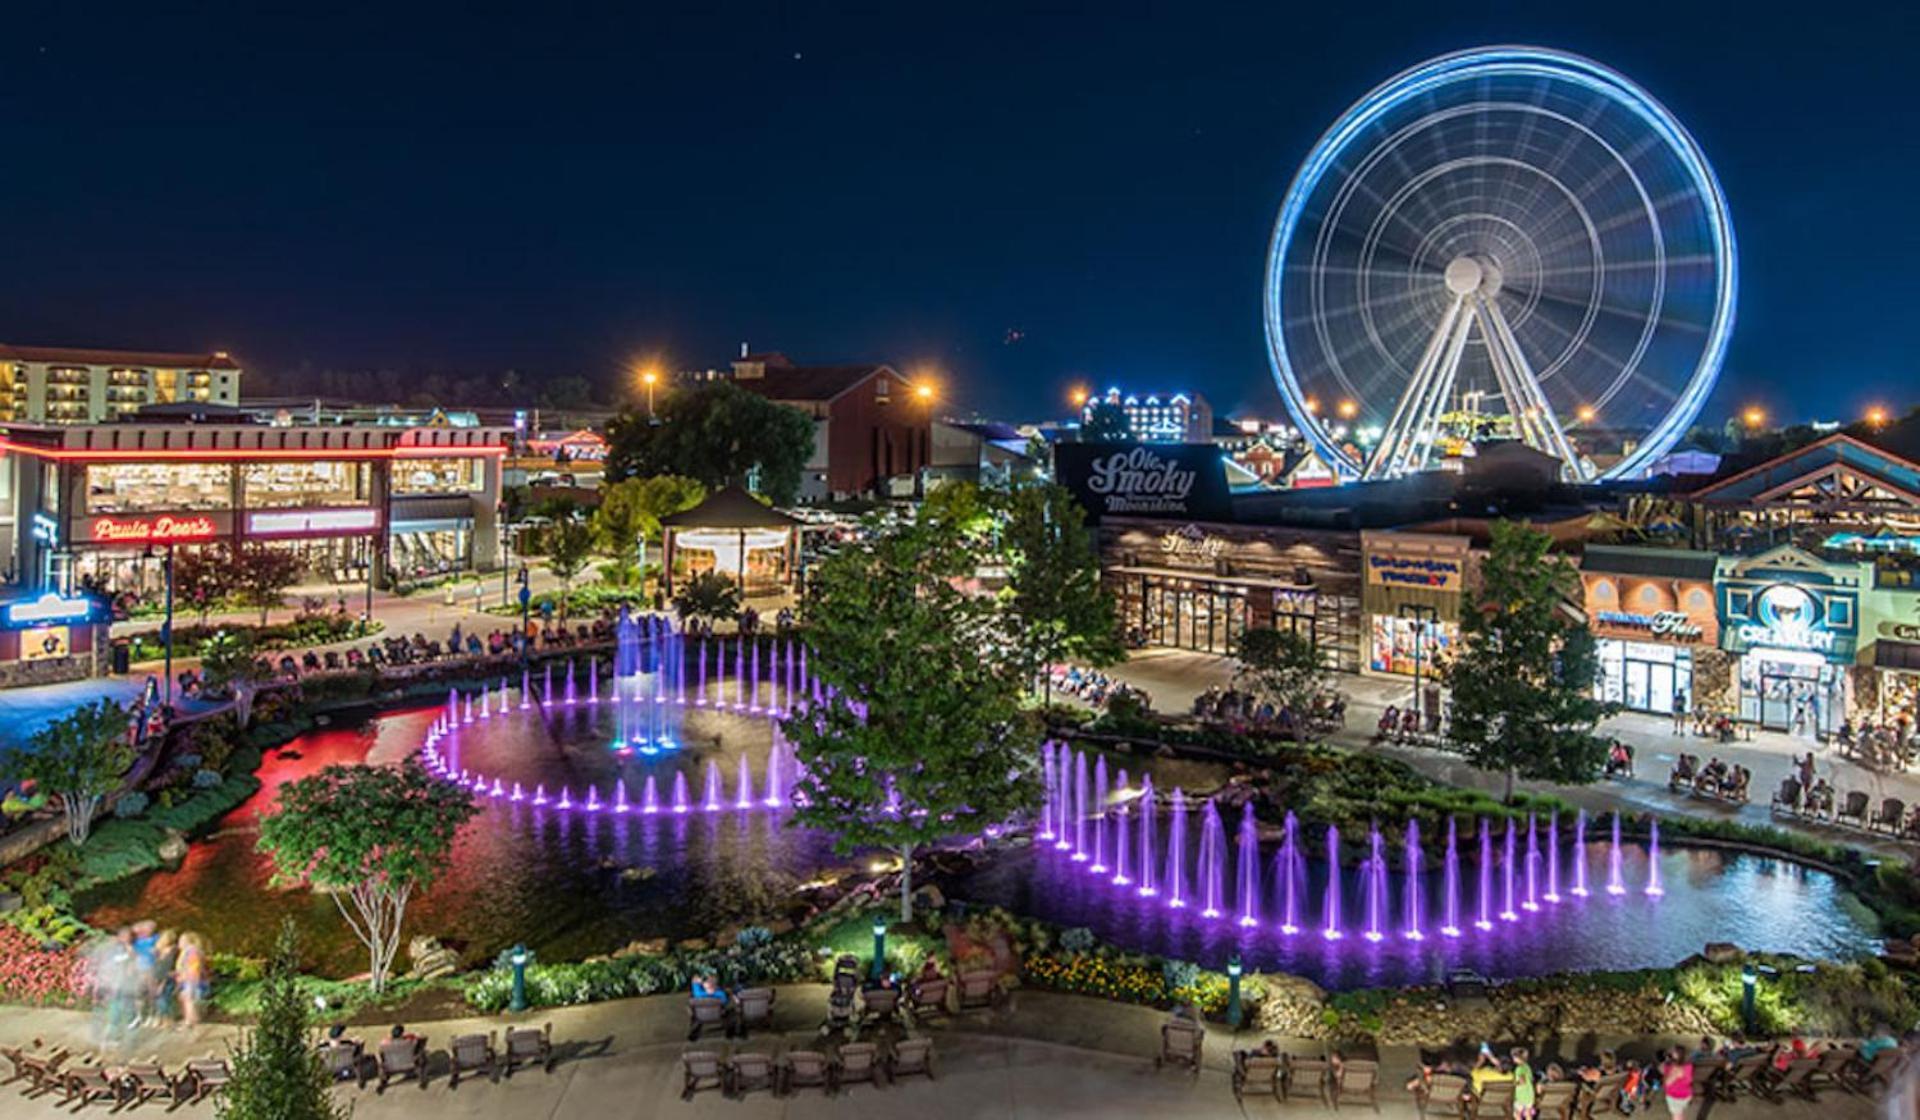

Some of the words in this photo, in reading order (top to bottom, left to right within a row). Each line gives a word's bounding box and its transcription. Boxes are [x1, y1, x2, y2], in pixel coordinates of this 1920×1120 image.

[1129, 447, 1165, 470] Ole
[1088, 453, 1196, 499] Smoky
[95, 518, 150, 540] Paula
[152, 517, 212, 538] Deen's
